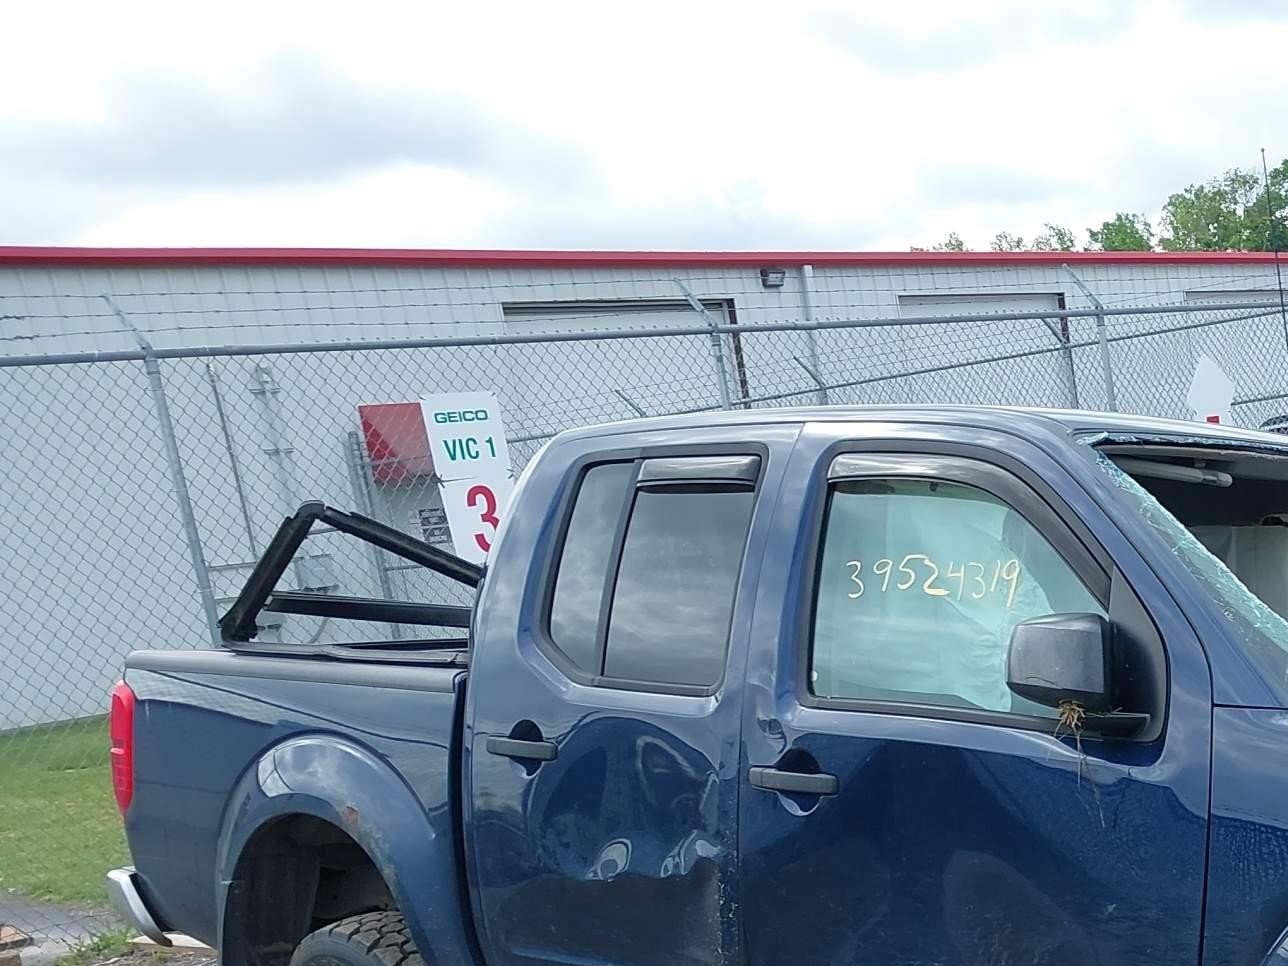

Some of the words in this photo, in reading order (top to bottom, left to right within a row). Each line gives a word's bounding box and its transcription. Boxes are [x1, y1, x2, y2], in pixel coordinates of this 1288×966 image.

[434, 409, 488, 423] GEICO
[443, 438, 480, 461] VIC
[485, 436, 497, 458] 1
[467, 485, 499, 552] 3
[845, 554, 1021, 608] 39524319
